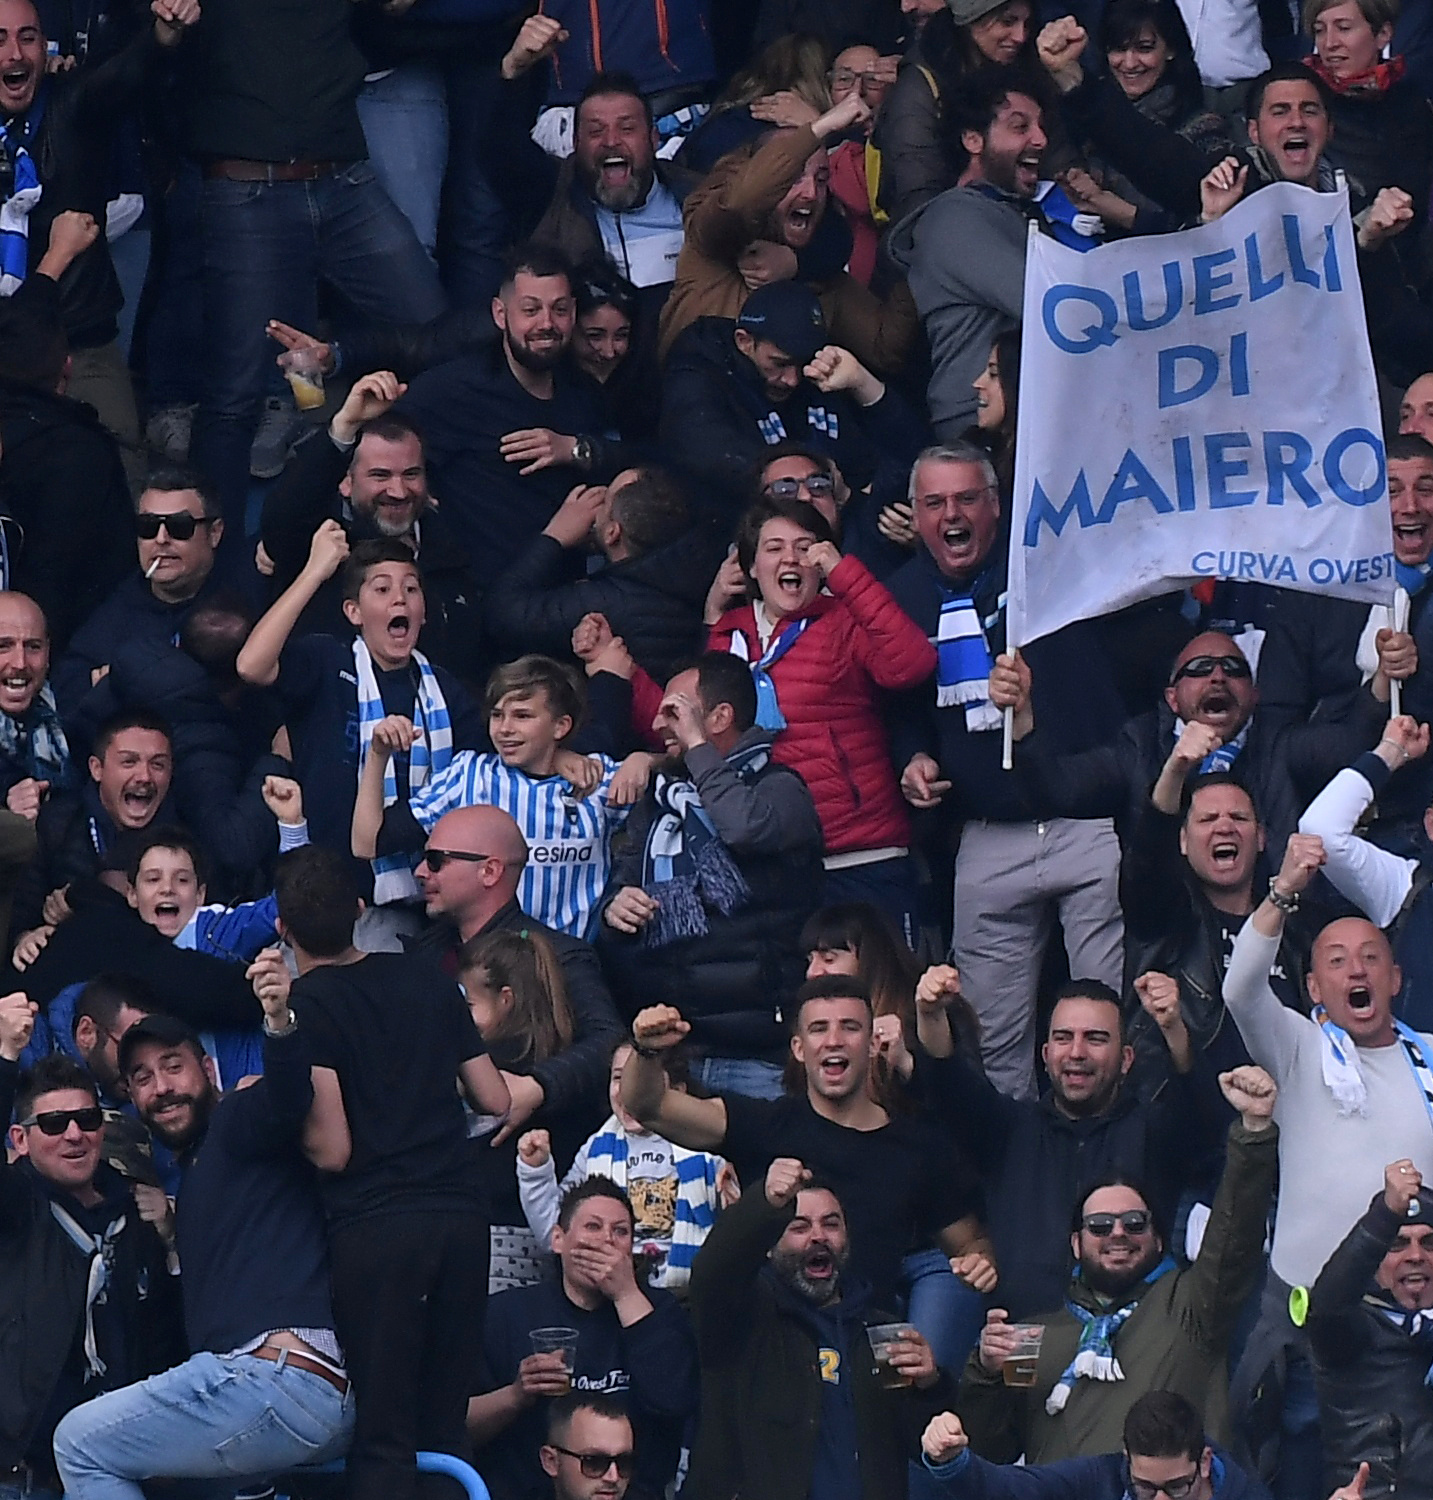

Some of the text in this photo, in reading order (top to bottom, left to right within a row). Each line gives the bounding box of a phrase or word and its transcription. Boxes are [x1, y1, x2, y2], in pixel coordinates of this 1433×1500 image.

[1041, 214, 1343, 355] QUELLI
[1158, 332, 1250, 409] DI
[1022, 428, 1386, 548] MAIERO
[1191, 551, 1394, 585] CURVA OVEST
